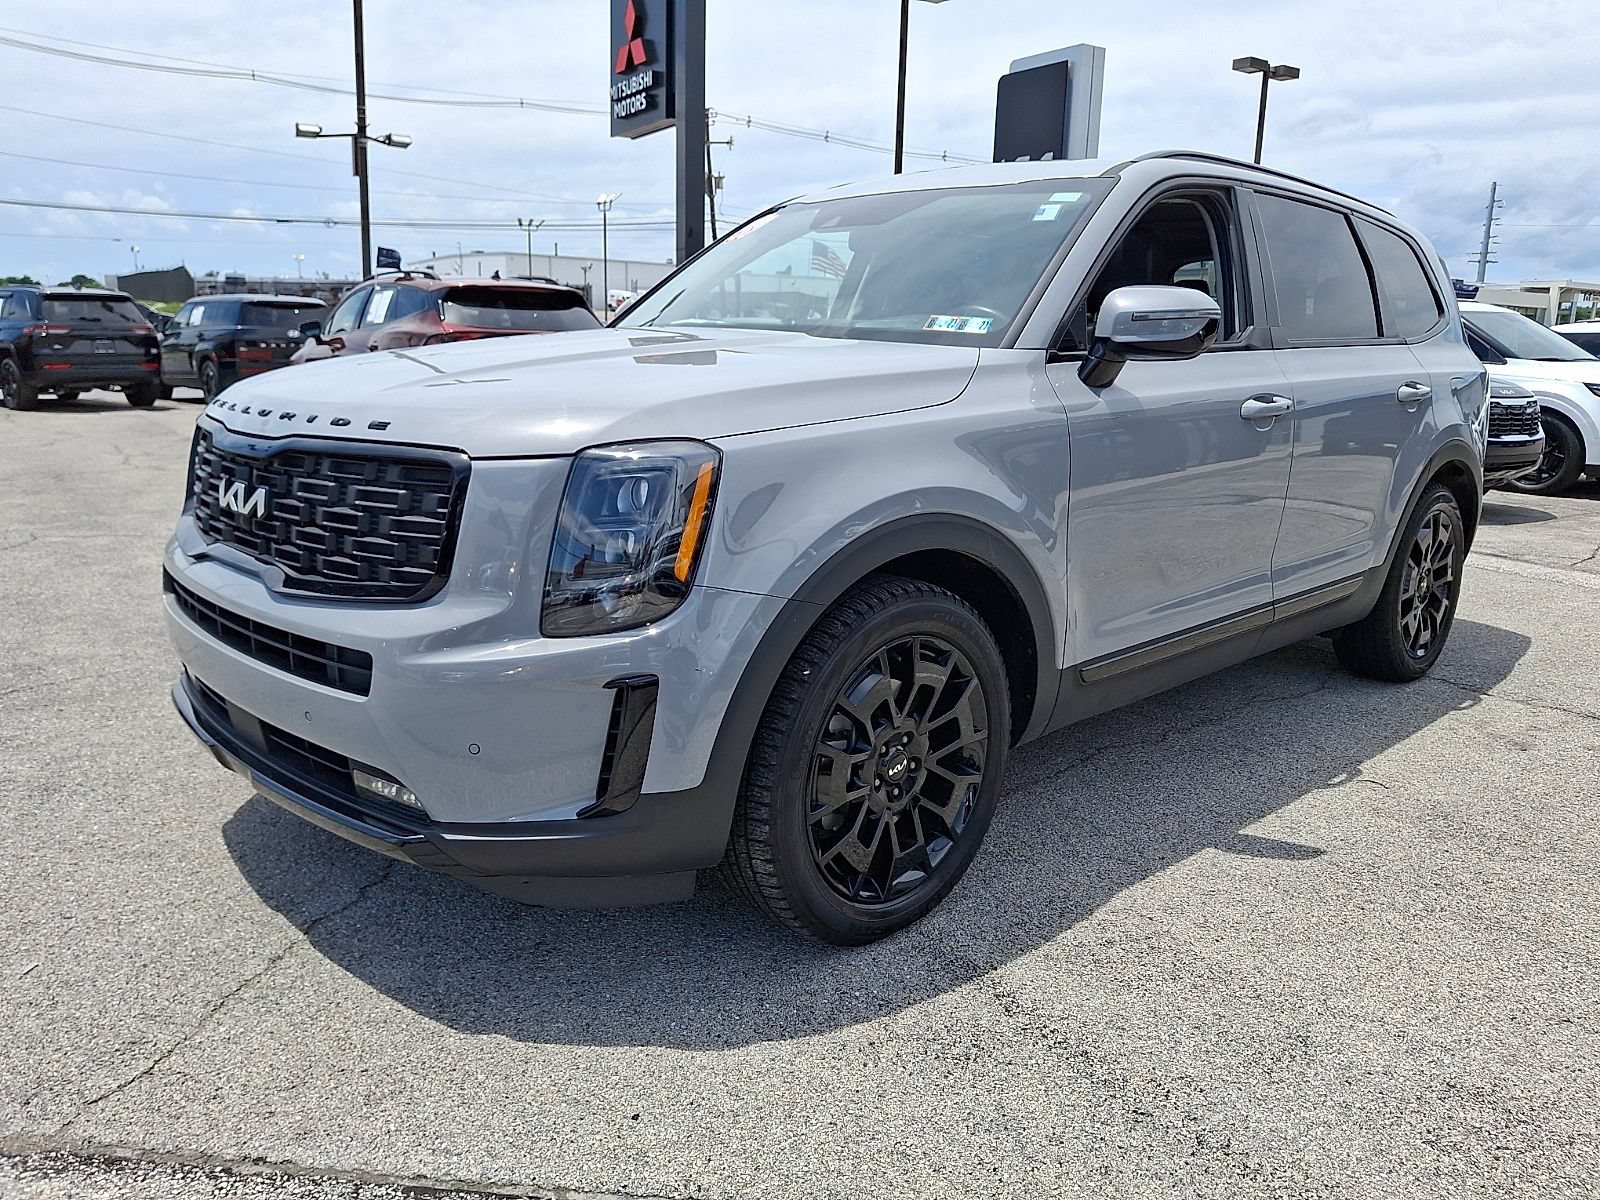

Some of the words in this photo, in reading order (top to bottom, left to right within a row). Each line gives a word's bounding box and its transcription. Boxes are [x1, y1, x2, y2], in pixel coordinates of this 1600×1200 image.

[609, 69, 653, 100] MITSUBISHI
[614, 92, 647, 118] MOTORS
[219, 477, 267, 519] KIA
